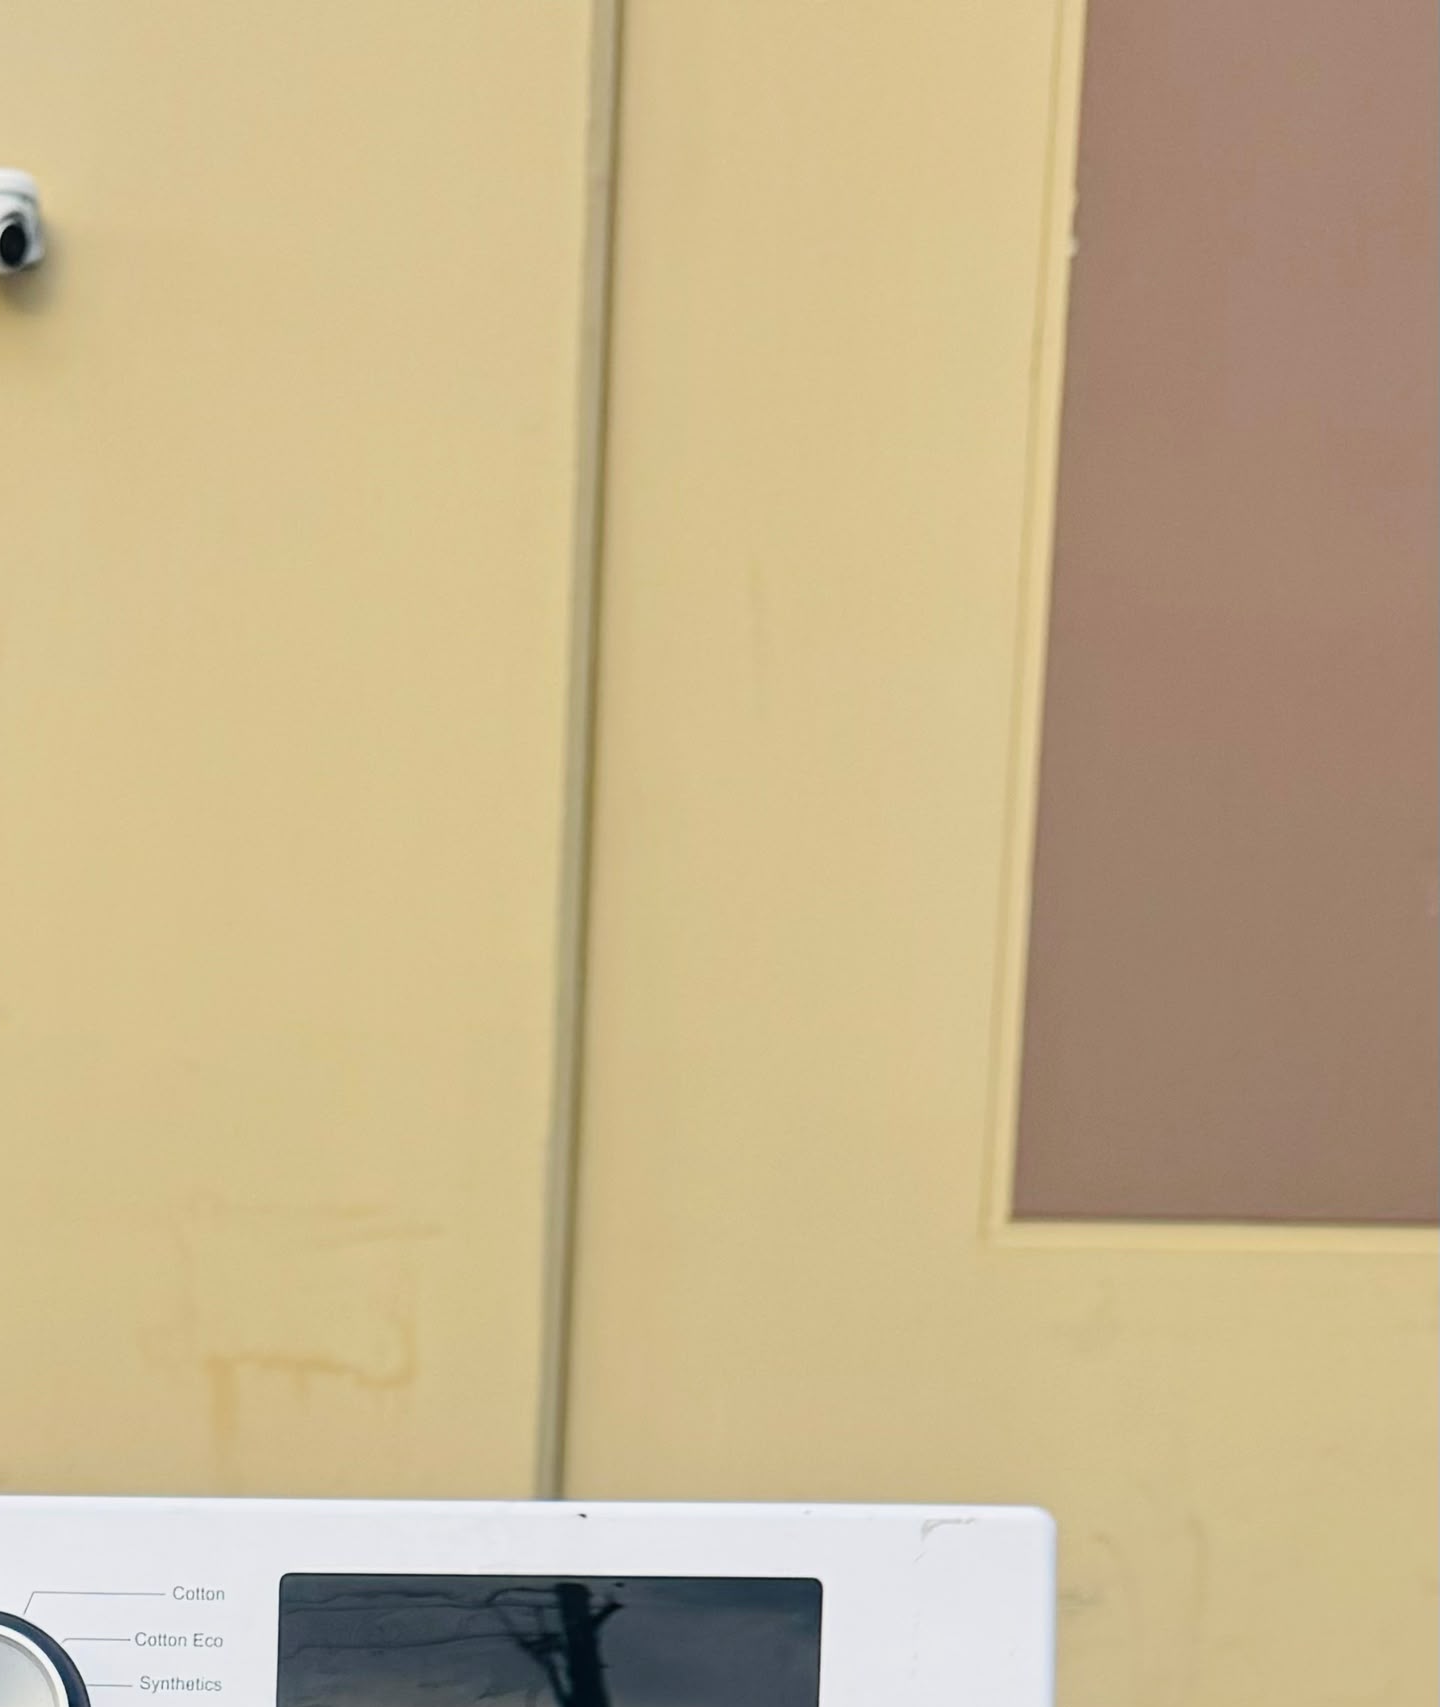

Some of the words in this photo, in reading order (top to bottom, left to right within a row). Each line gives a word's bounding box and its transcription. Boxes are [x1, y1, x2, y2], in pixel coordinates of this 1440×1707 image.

[172, 1587, 225, 1601] Cotton
[134, 1632, 188, 1648] Cotton
[193, 1634, 224, 1648] Eco
[139, 1676, 222, 1696] Synthetics
